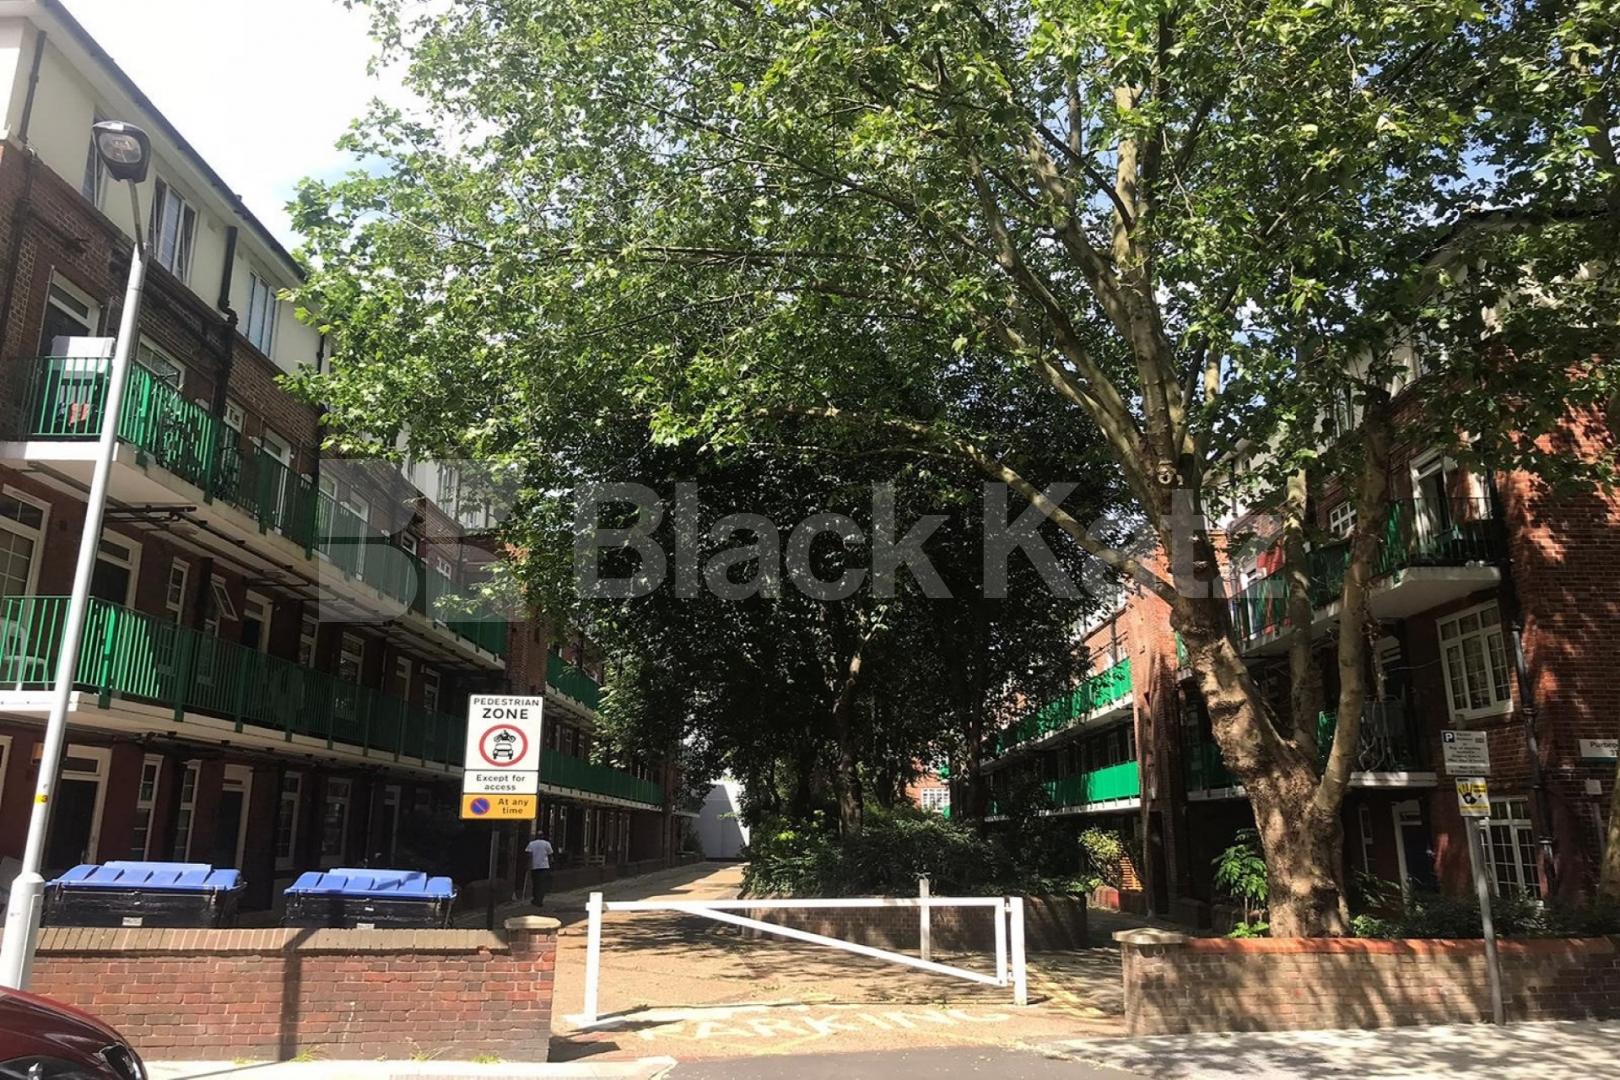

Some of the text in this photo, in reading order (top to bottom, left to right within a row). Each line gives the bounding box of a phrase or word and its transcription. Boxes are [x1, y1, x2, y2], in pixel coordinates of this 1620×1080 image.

[473, 697, 540, 707] PEDESTRIAN
[482, 708, 529, 720] ZONE
[476, 774, 526, 782] Except for
[497, 798, 510, 806] At
[636, 1008, 1012, 1040] PARKING
